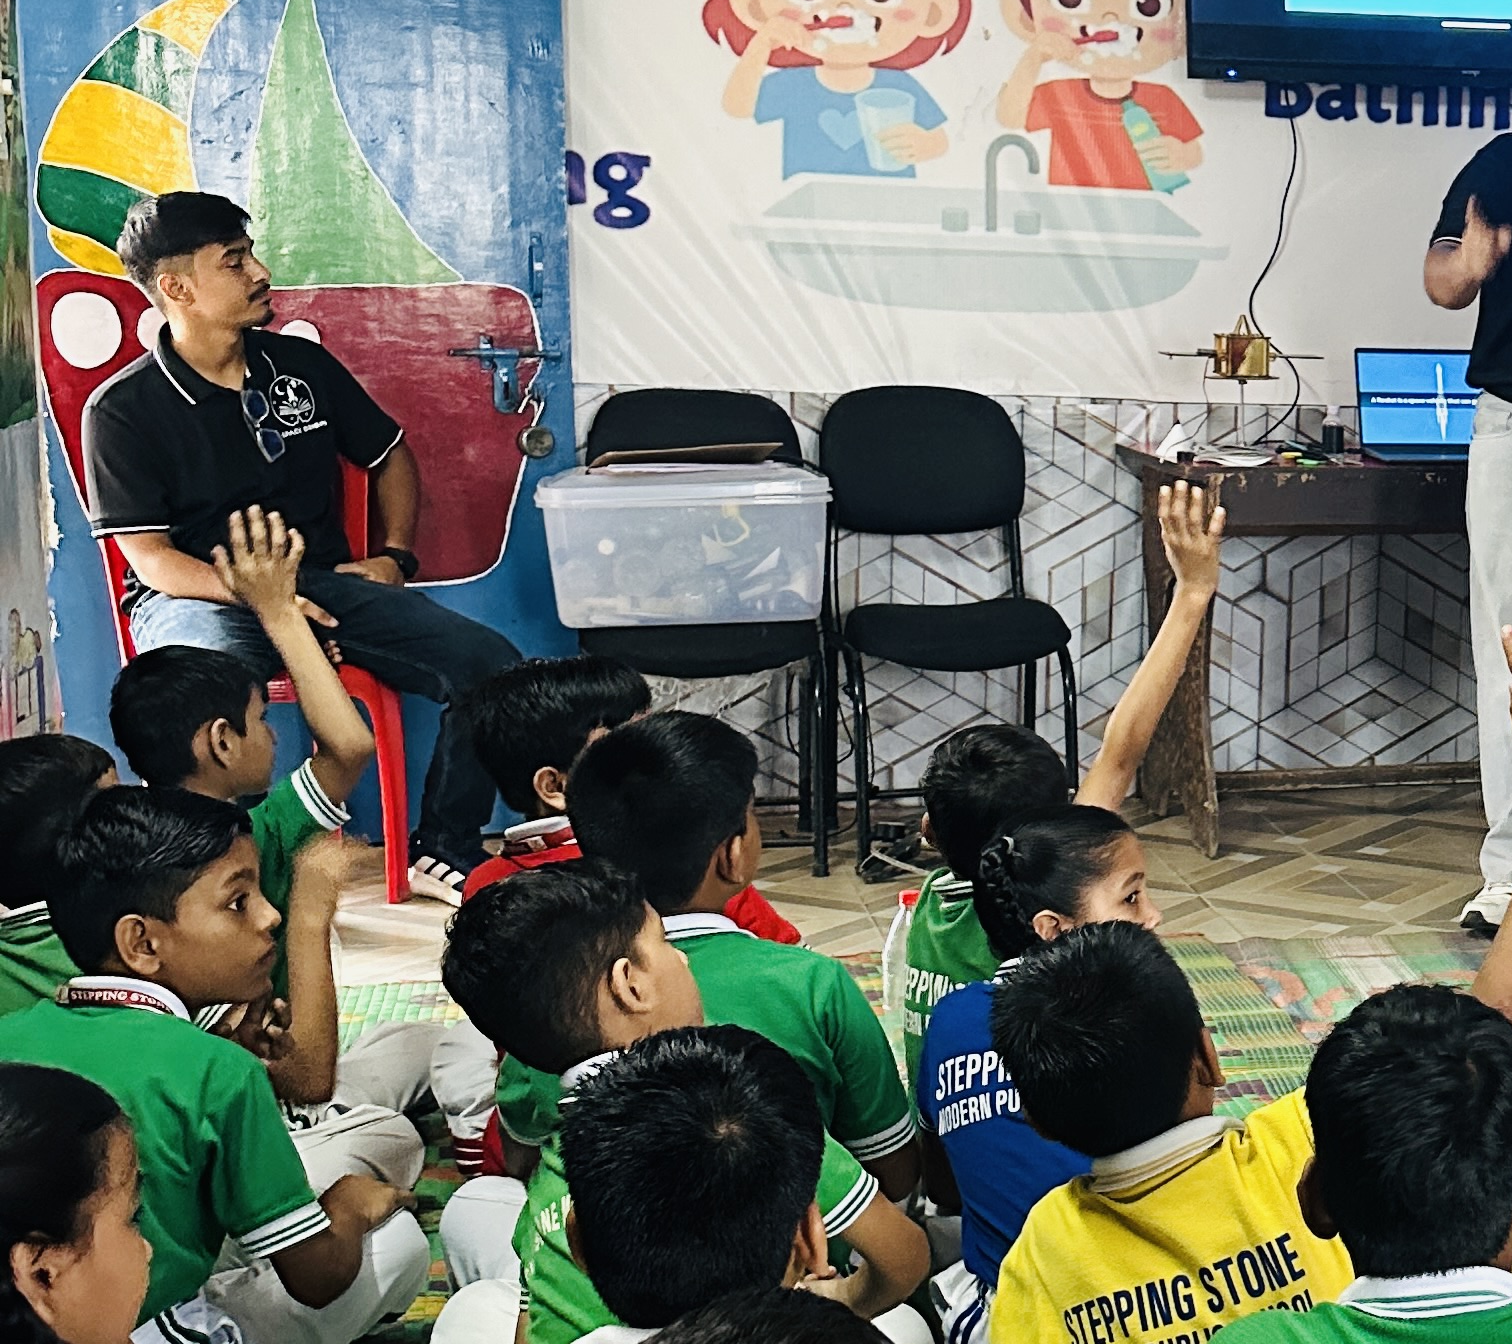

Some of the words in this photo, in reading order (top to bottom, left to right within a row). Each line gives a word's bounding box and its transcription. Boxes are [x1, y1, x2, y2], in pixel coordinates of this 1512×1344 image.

[70, 990, 128, 1002] STEPPING
[938, 1092, 992, 1136] MODERN
[1198, 1233, 1306, 1314] STONE
